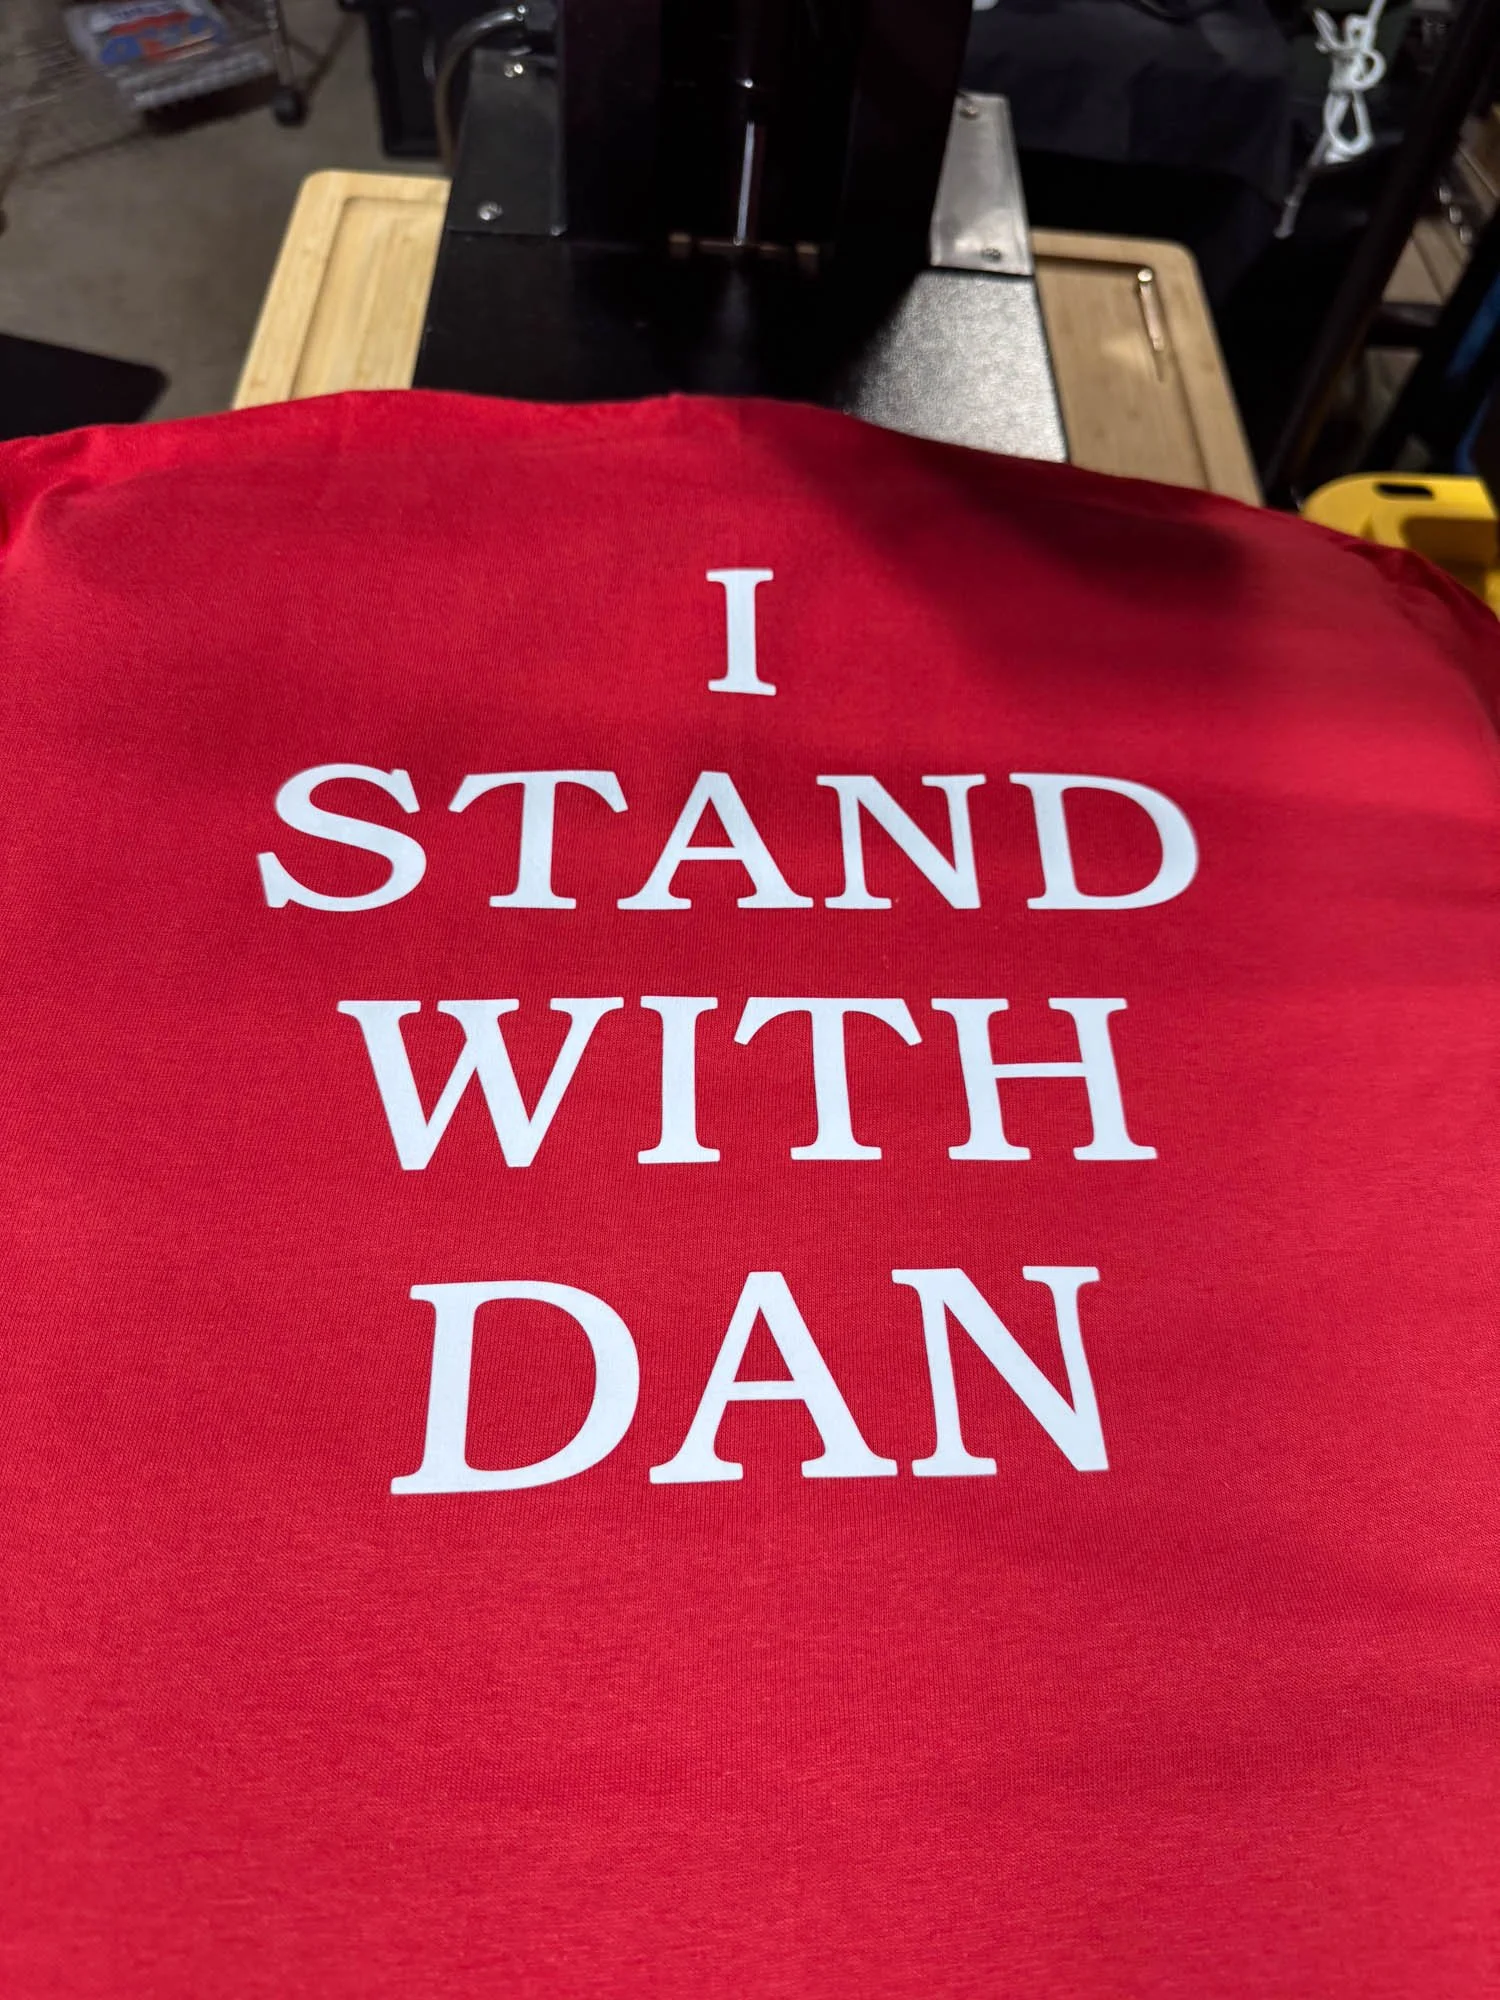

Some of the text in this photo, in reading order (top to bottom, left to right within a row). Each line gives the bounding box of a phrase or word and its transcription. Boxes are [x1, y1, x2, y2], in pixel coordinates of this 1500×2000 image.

[706, 568, 777, 696] I
[257, 763, 1199, 912] STAND
[337, 996, 1158, 1171] WITH
[390, 1265, 1109, 1495] DAN
